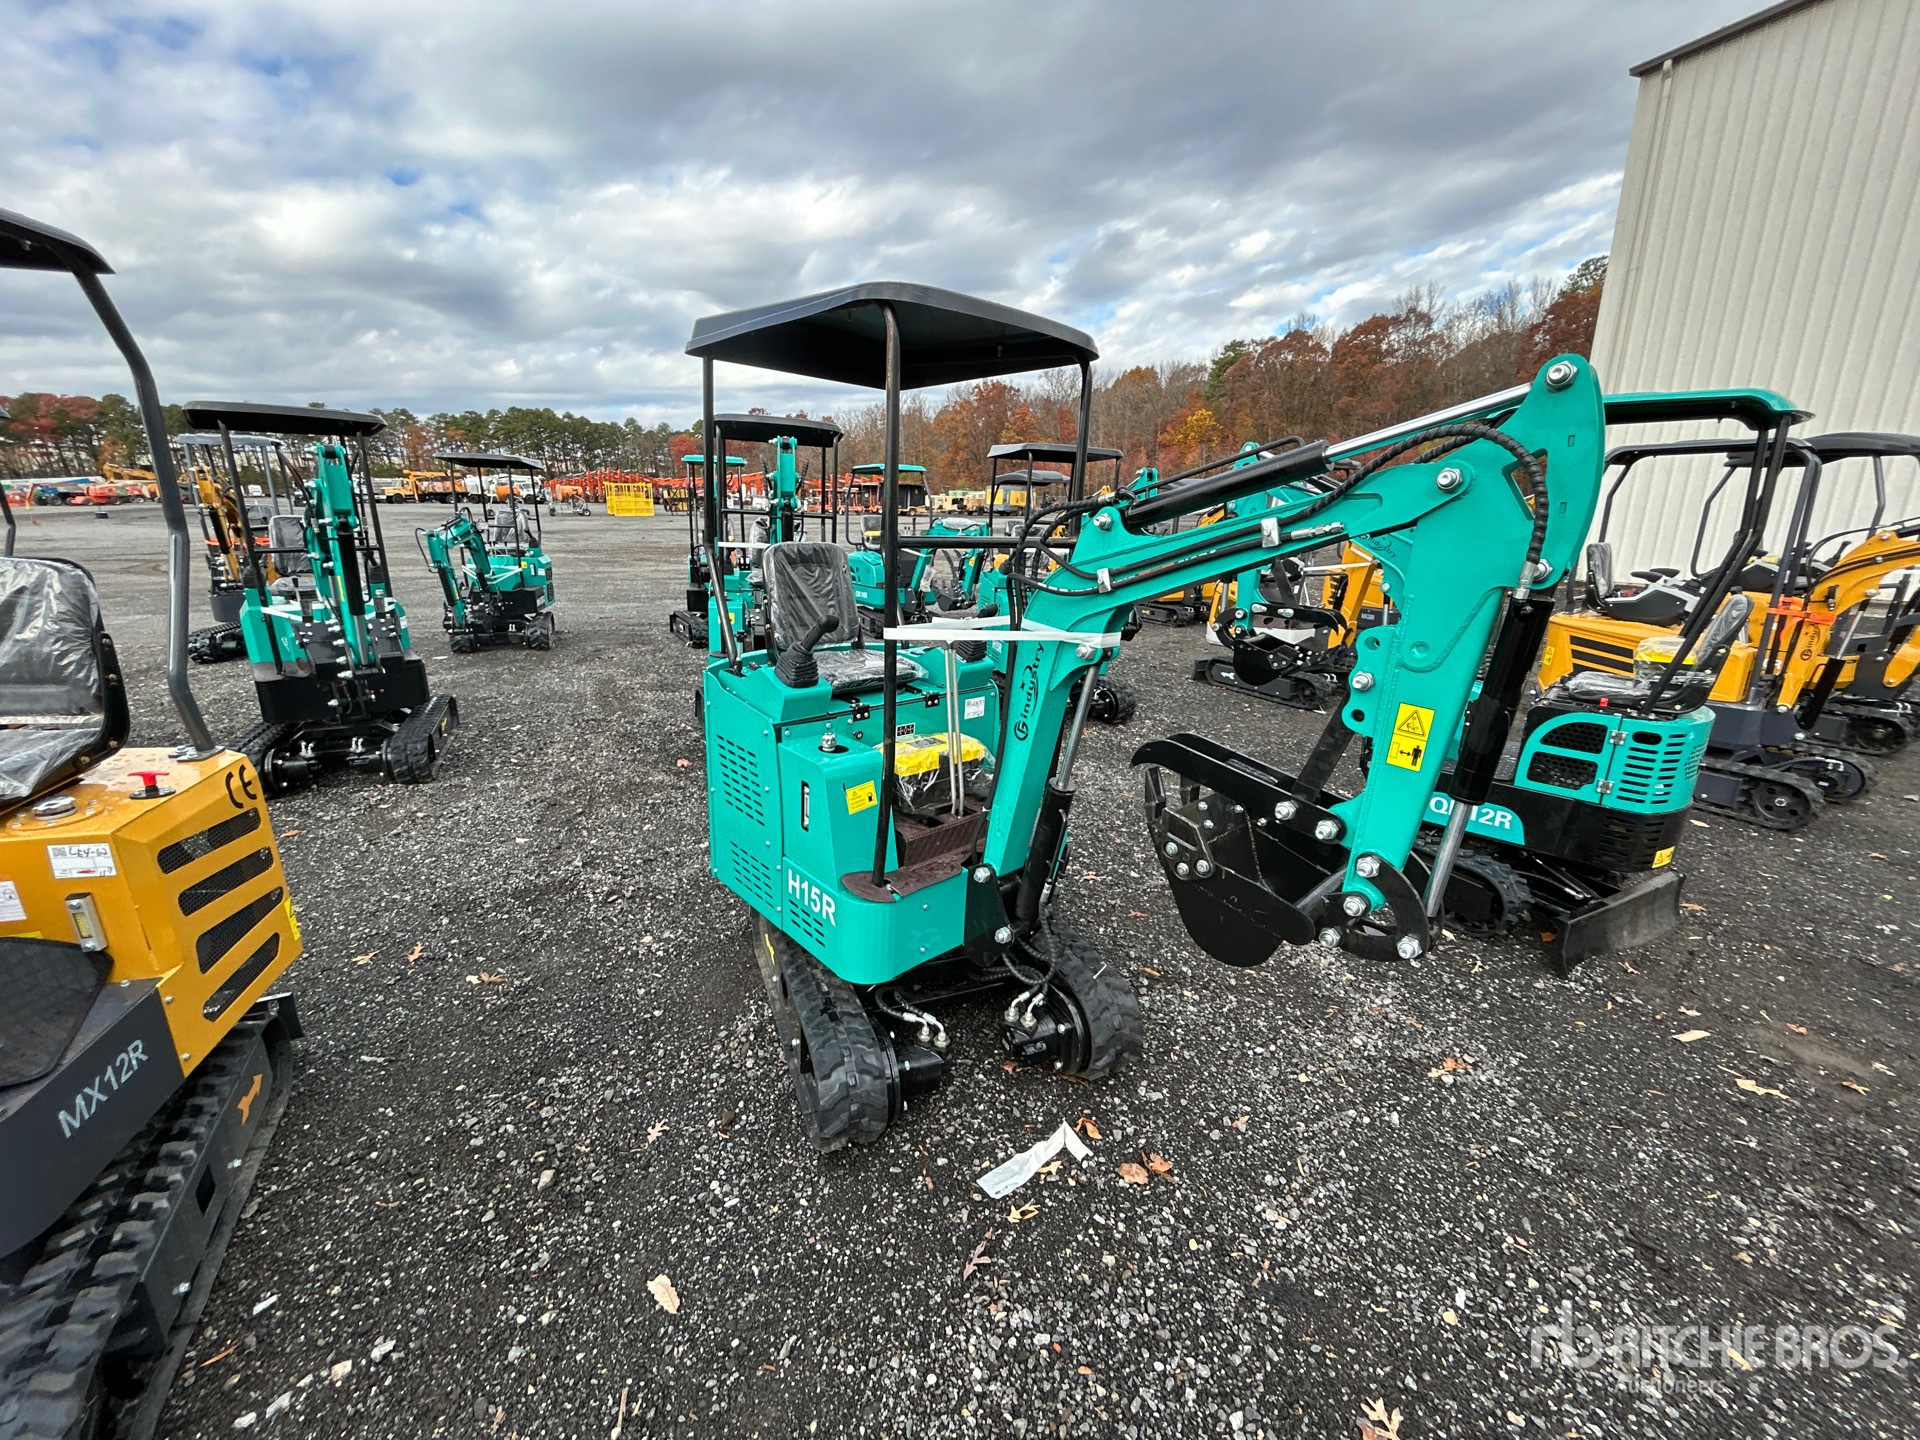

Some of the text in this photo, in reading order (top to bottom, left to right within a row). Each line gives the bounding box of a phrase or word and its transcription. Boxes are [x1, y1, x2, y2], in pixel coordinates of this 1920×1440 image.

[225, 764, 257, 809] CE
[788, 868, 837, 928] H15R
[58, 1039, 149, 1139] MX12R
